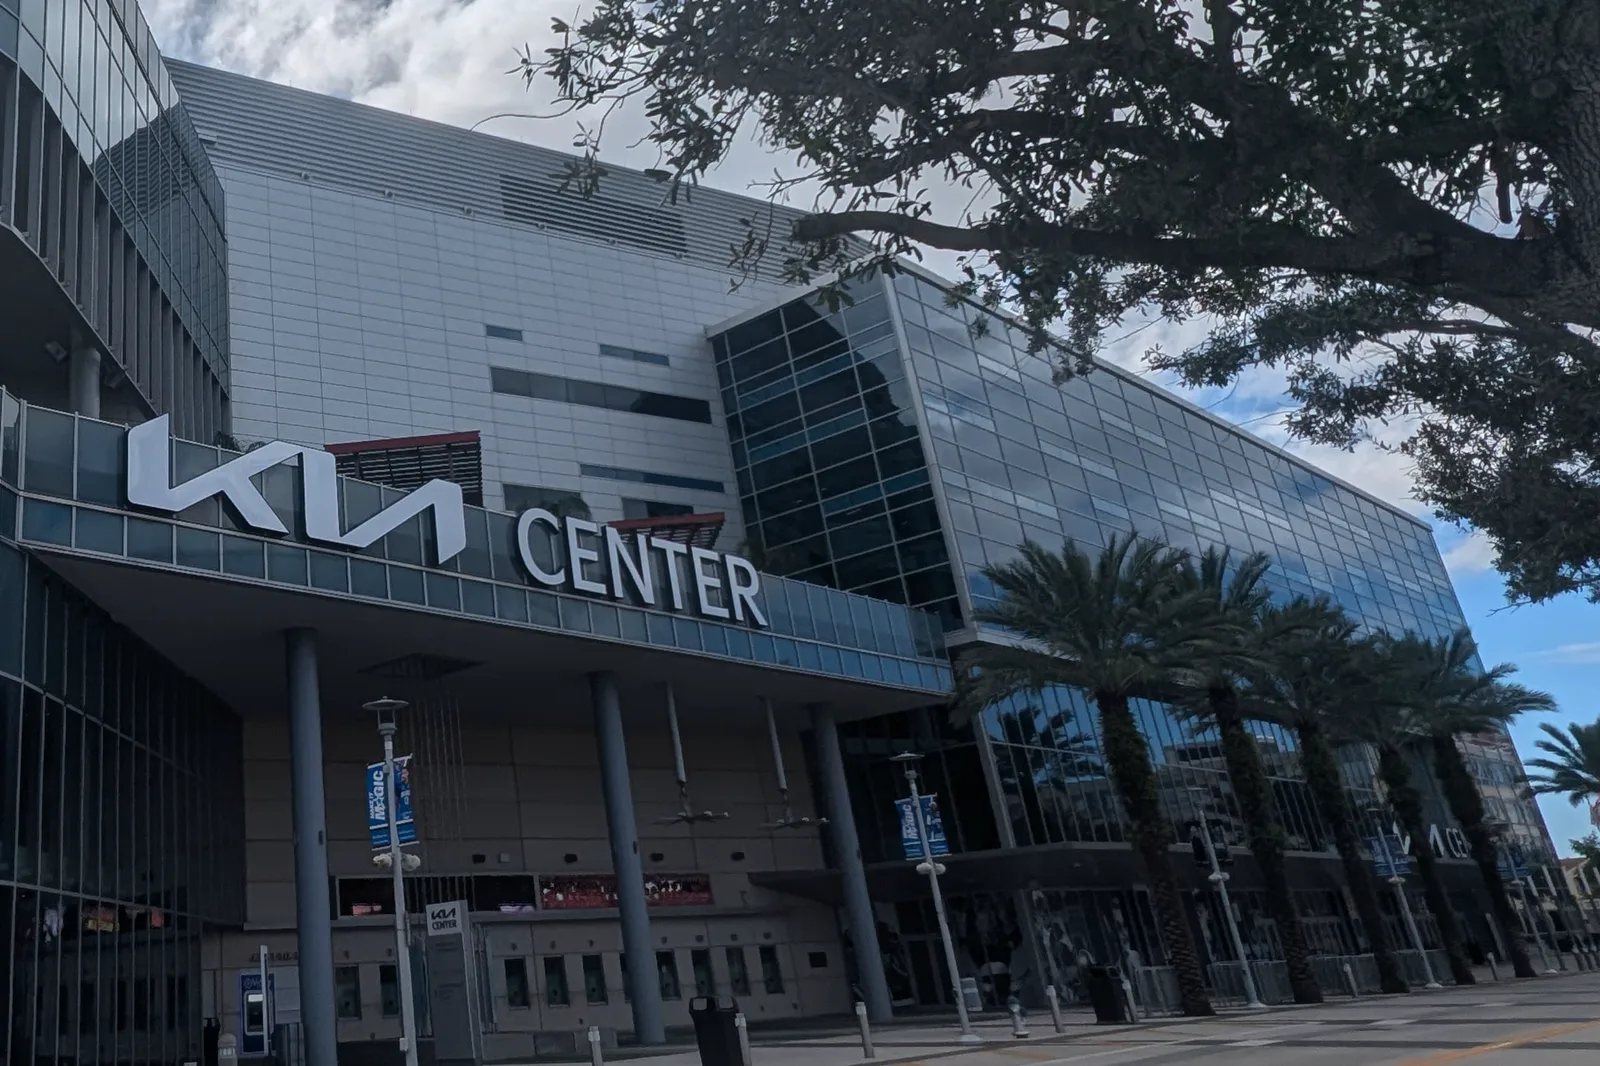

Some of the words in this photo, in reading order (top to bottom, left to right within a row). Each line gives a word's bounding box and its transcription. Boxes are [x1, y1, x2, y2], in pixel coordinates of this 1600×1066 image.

[127, 412, 466, 565] KIA
[517, 507, 768, 627] CENTER
[431, 907, 457, 920] KIA
[432, 919, 458, 930] CENTER
